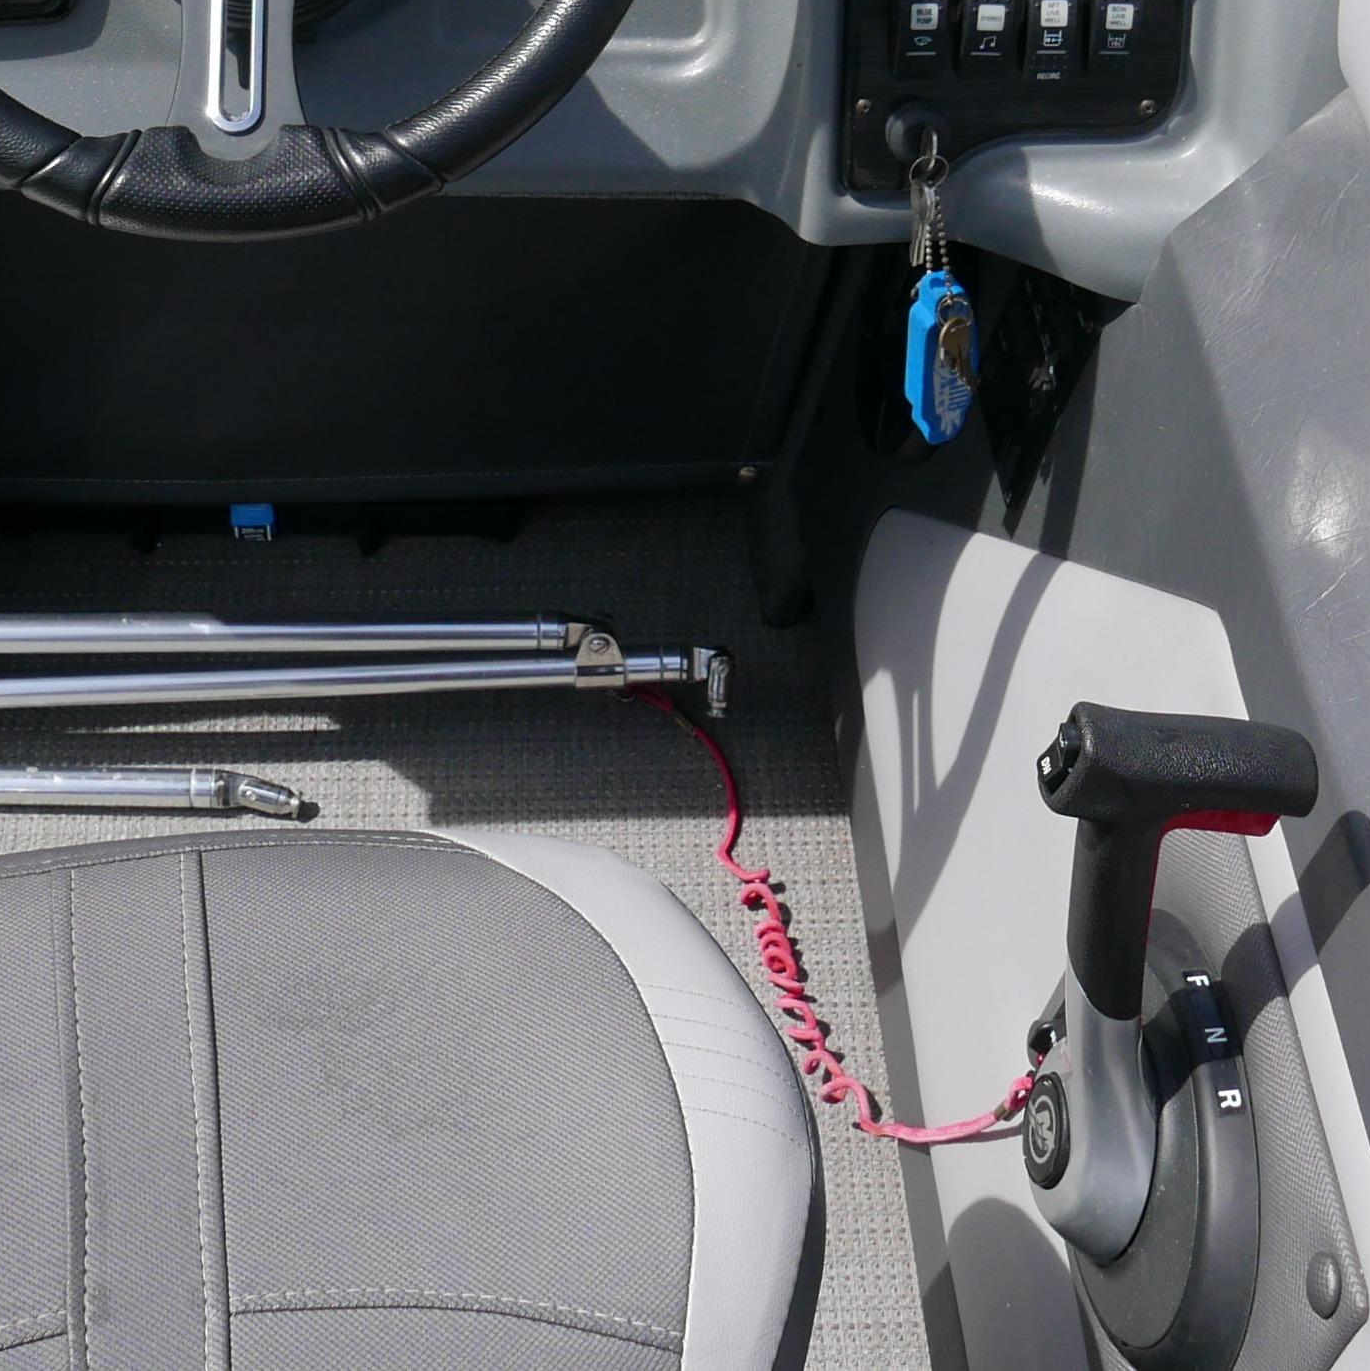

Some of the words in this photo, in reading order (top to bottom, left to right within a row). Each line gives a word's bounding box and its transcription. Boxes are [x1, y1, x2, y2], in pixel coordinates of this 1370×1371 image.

[1037, 72, 1061, 80] RECIRC
[1186, 975, 1210, 987] F
[1204, 1027, 1228, 1044] N
[1218, 1089, 1242, 1109] R
